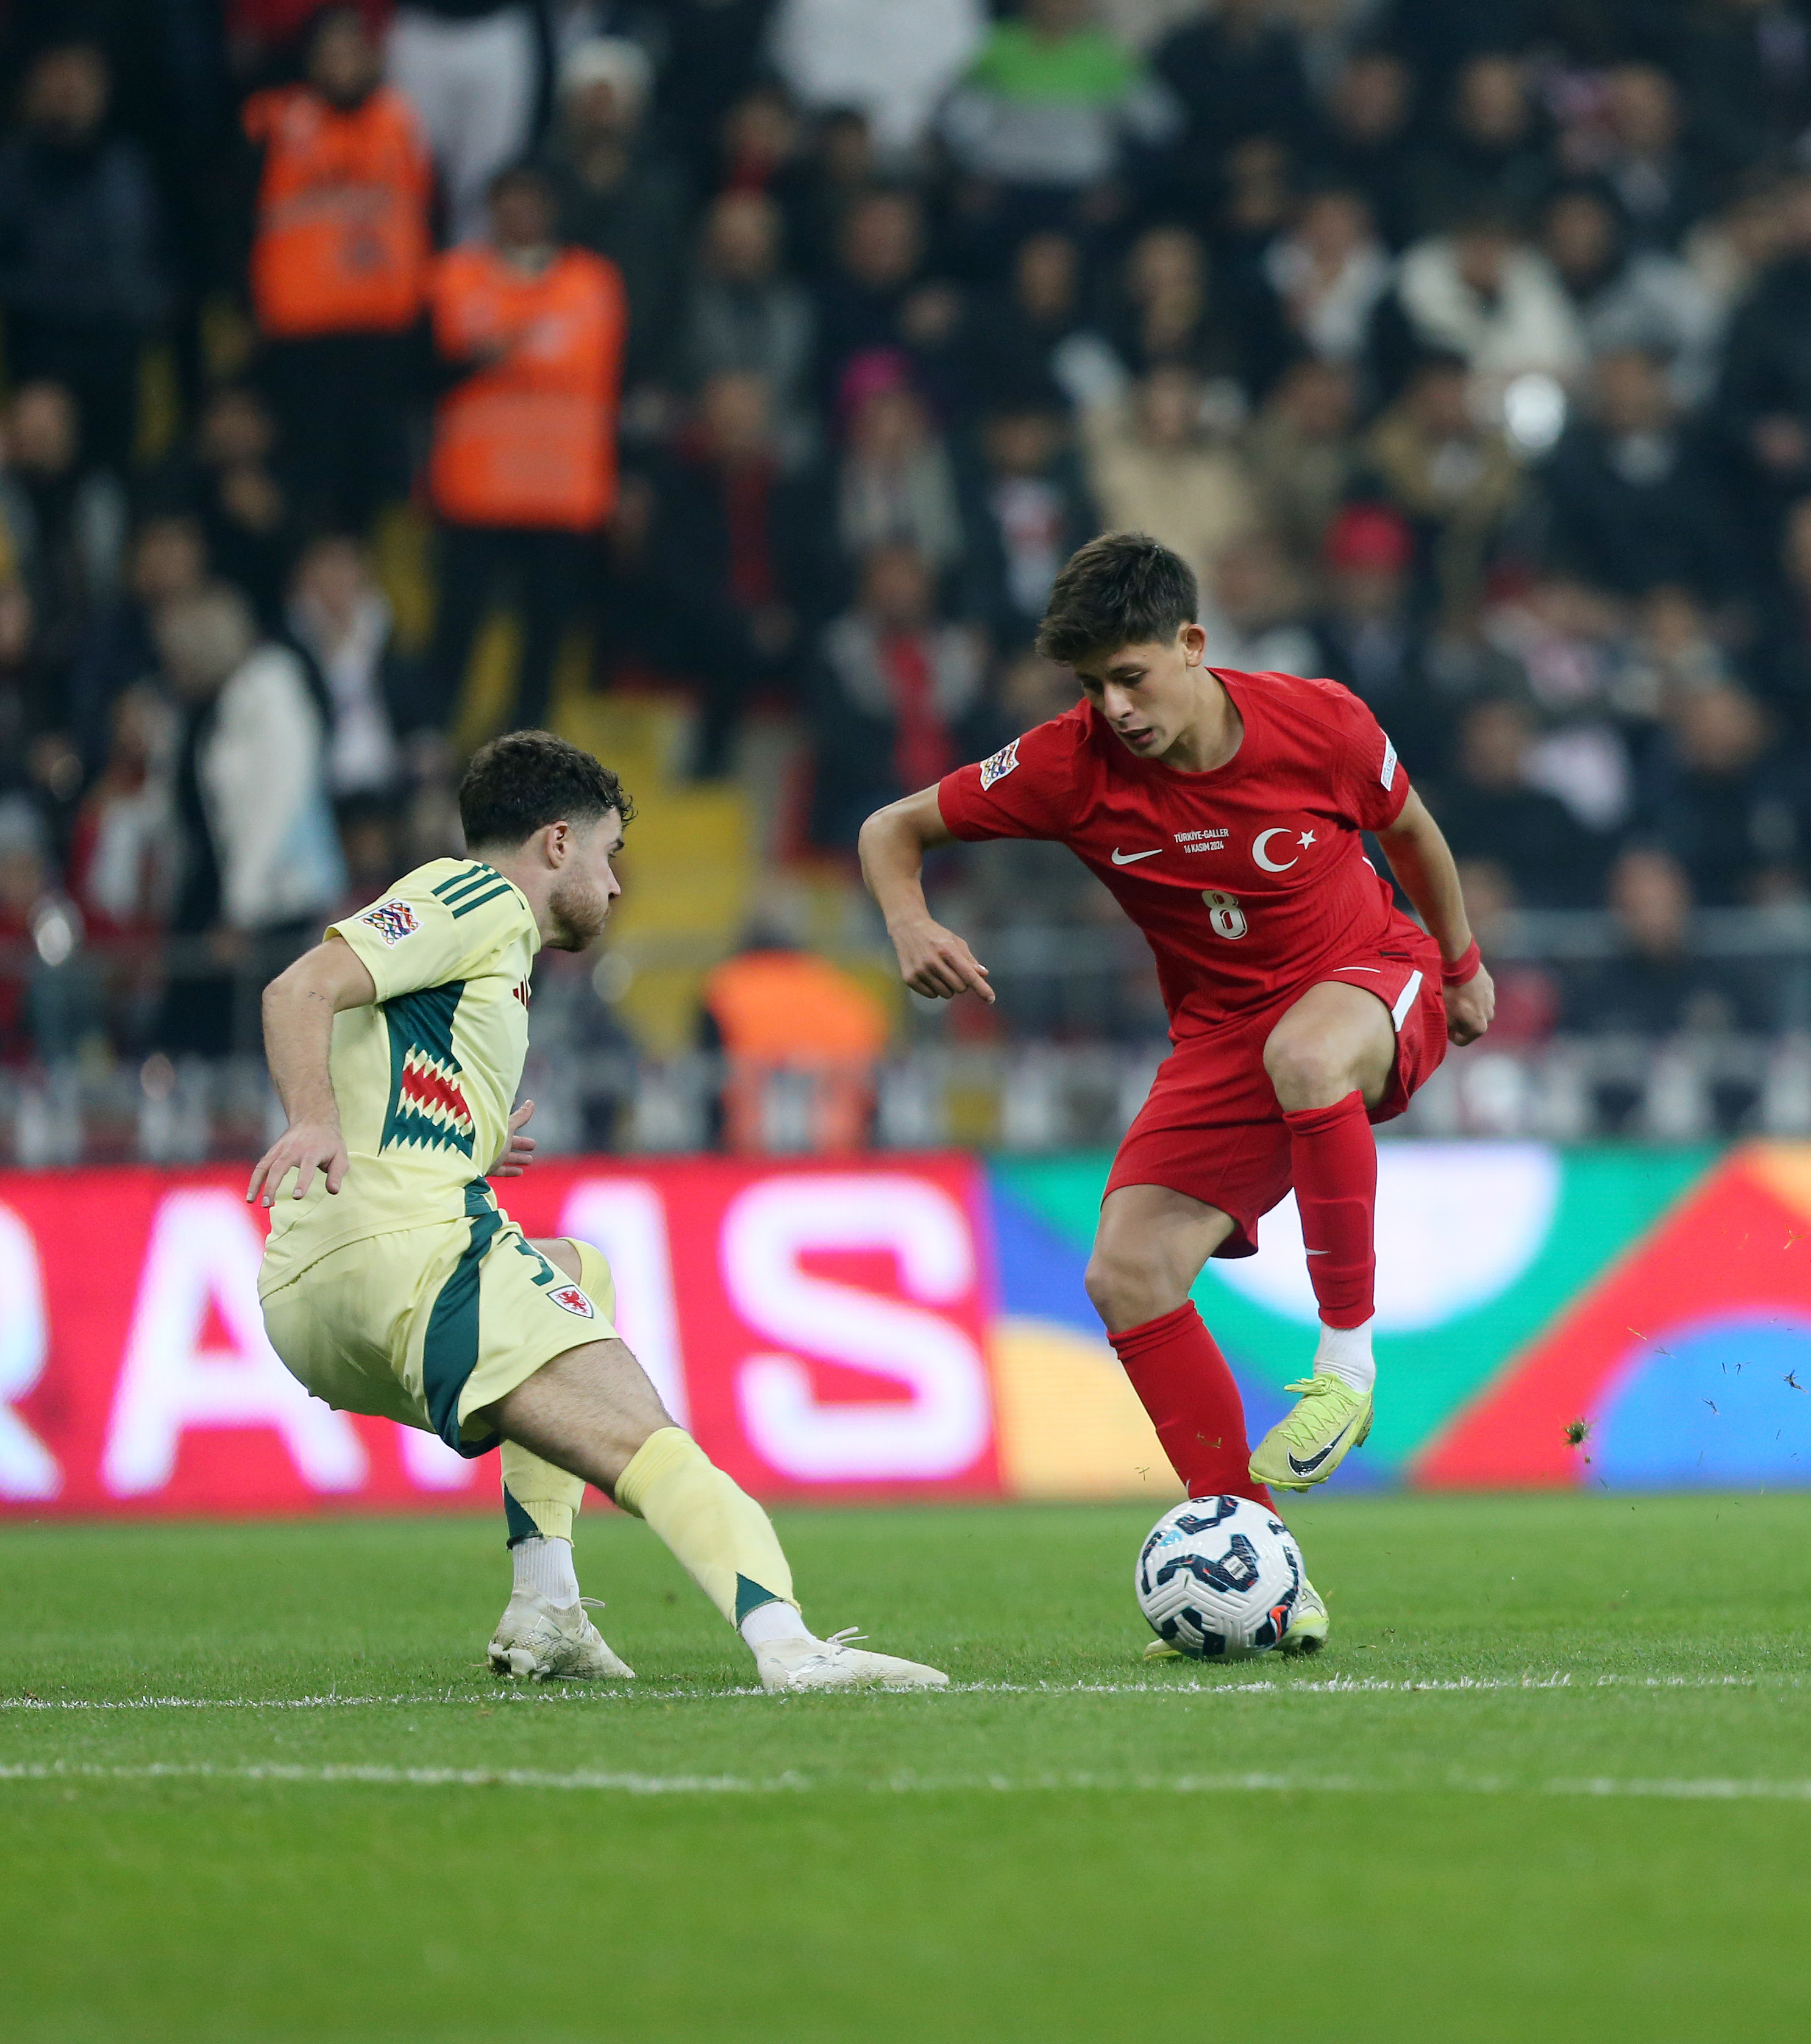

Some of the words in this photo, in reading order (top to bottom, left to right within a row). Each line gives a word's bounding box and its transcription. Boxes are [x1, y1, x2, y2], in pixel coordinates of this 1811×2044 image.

[1174, 829, 1228, 842] TÜRKİYE-GALLER
[1191, 843, 1210, 853] KASIM
[1211, 841, 1224, 850] 2024
[1202, 890, 1247, 939] 8
[497, 1231, 555, 1287] 3
